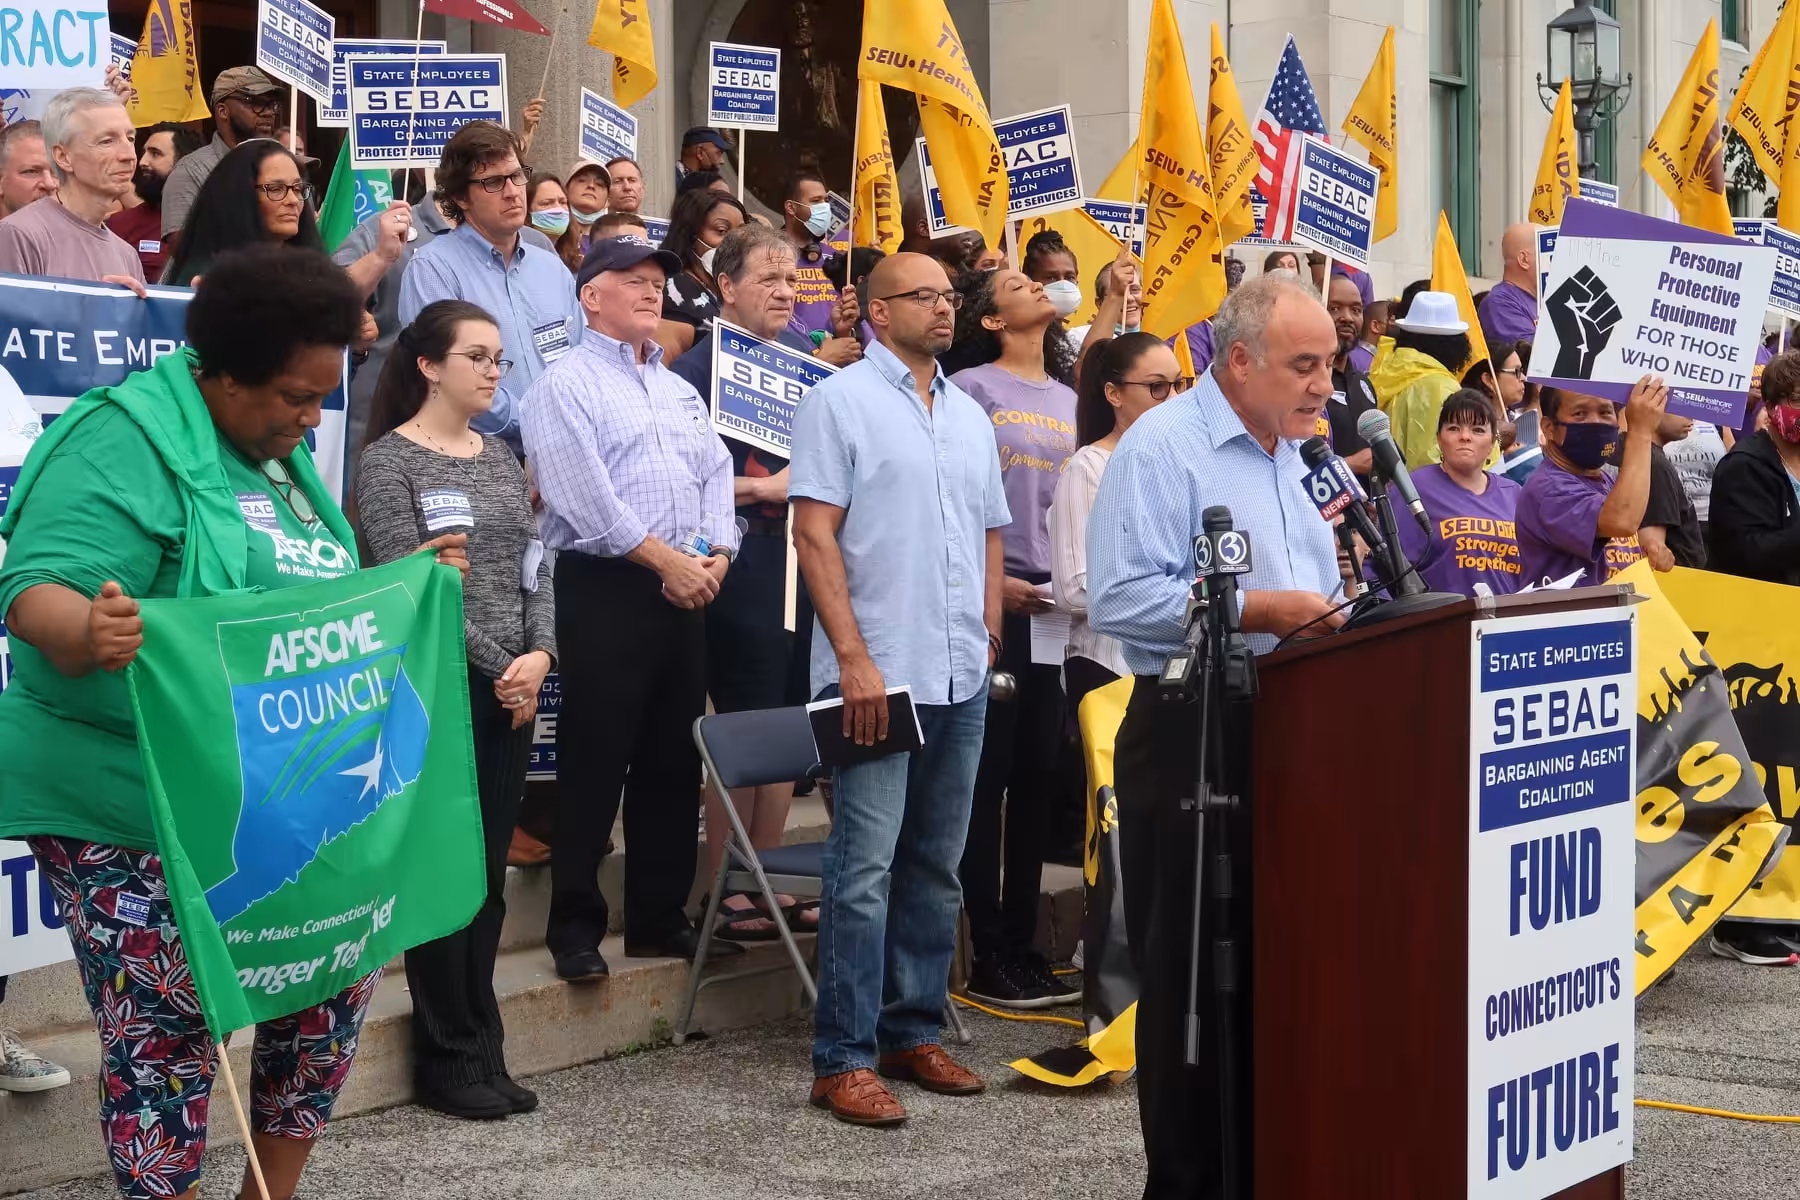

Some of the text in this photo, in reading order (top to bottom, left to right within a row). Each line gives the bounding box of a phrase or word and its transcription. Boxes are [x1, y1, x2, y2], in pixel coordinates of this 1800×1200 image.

[268, 8, 325, 55] SEBAC
[290, 3, 327, 32] EMPLOYEES
[0, 8, 107, 68] RACT
[264, 28, 327, 71] BARGAINING AGENT
[260, 50, 328, 97] PROTECT PUBLIC SERVICES
[279, 48, 313, 73] COALITION
[363, 70, 491, 80] STATE EMPLOYEES
[717, 54, 773, 67] STATE EMPLOYEES
[866, 47, 975, 102] SEIU Health
[718, 70, 771, 88] SEBAC
[368, 90, 489, 111] SEBAC
[714, 89, 773, 101] BARGAINING AGENT
[728, 100, 760, 109] COALITION
[361, 118, 446, 128] BARGANING
[712, 111, 733, 119] PROTECT
[1350, 115, 1373, 135] SEIU
[588, 113, 630, 147] SEBAC
[358, 147, 407, 158] PROTECT
[1145, 148, 1178, 175] SEIU
[1023, 164, 1066, 181] AGENT
[1309, 151, 1371, 189] STATE EMPLOYEES
[1024, 188, 1076, 207] SERVICES
[1308, 172, 1367, 215] SEBAC
[1302, 195, 1368, 233] BARGAINING AGENT
[1316, 215, 1352, 238] COALITION
[1296, 222, 1367, 261] PROTECT PUBLIC SERVICES
[1767, 235, 1782, 247] STATE
[1669, 245, 1743, 281] Personal
[796, 293, 838, 304] Together
[1657, 271, 1741, 309] Protective
[1772, 284, 1799, 299] COALITION
[1650, 298, 1738, 336] Equipment
[2, 327, 78, 363] ATE
[536, 328, 566, 343] SEBAC
[1636, 325, 1739, 362] FOR THOSE
[730, 339, 770, 363] STATE
[1621, 347, 1746, 389] WHO NEED IT
[719, 412, 768, 438] PROTECT
[1311, 466, 1341, 502] 61
[422, 498, 468, 509] SEBAC
[1322, 493, 1350, 518] NEWS
[1444, 519, 1492, 536] SEIU
[276, 562, 292, 574] We
[293, 565, 314, 577] Make
[264, 611, 384, 677] AFSCME
[1489, 641, 1624, 673] STATE EMPLOYEES
[258, 667, 388, 733] COUNCIL
[1493, 683, 1619, 745] SEBAC
[1485, 745, 1625, 787] BARGAINING AGENT
[1519, 779, 1594, 809] COALITION
[1509, 826, 1602, 937] FUND
[226, 929, 254, 945] We
[259, 920, 299, 943] Make
[1485, 957, 1620, 1042] CONNECTICUT'S
[1487, 1042, 1620, 1181] FUTURE
